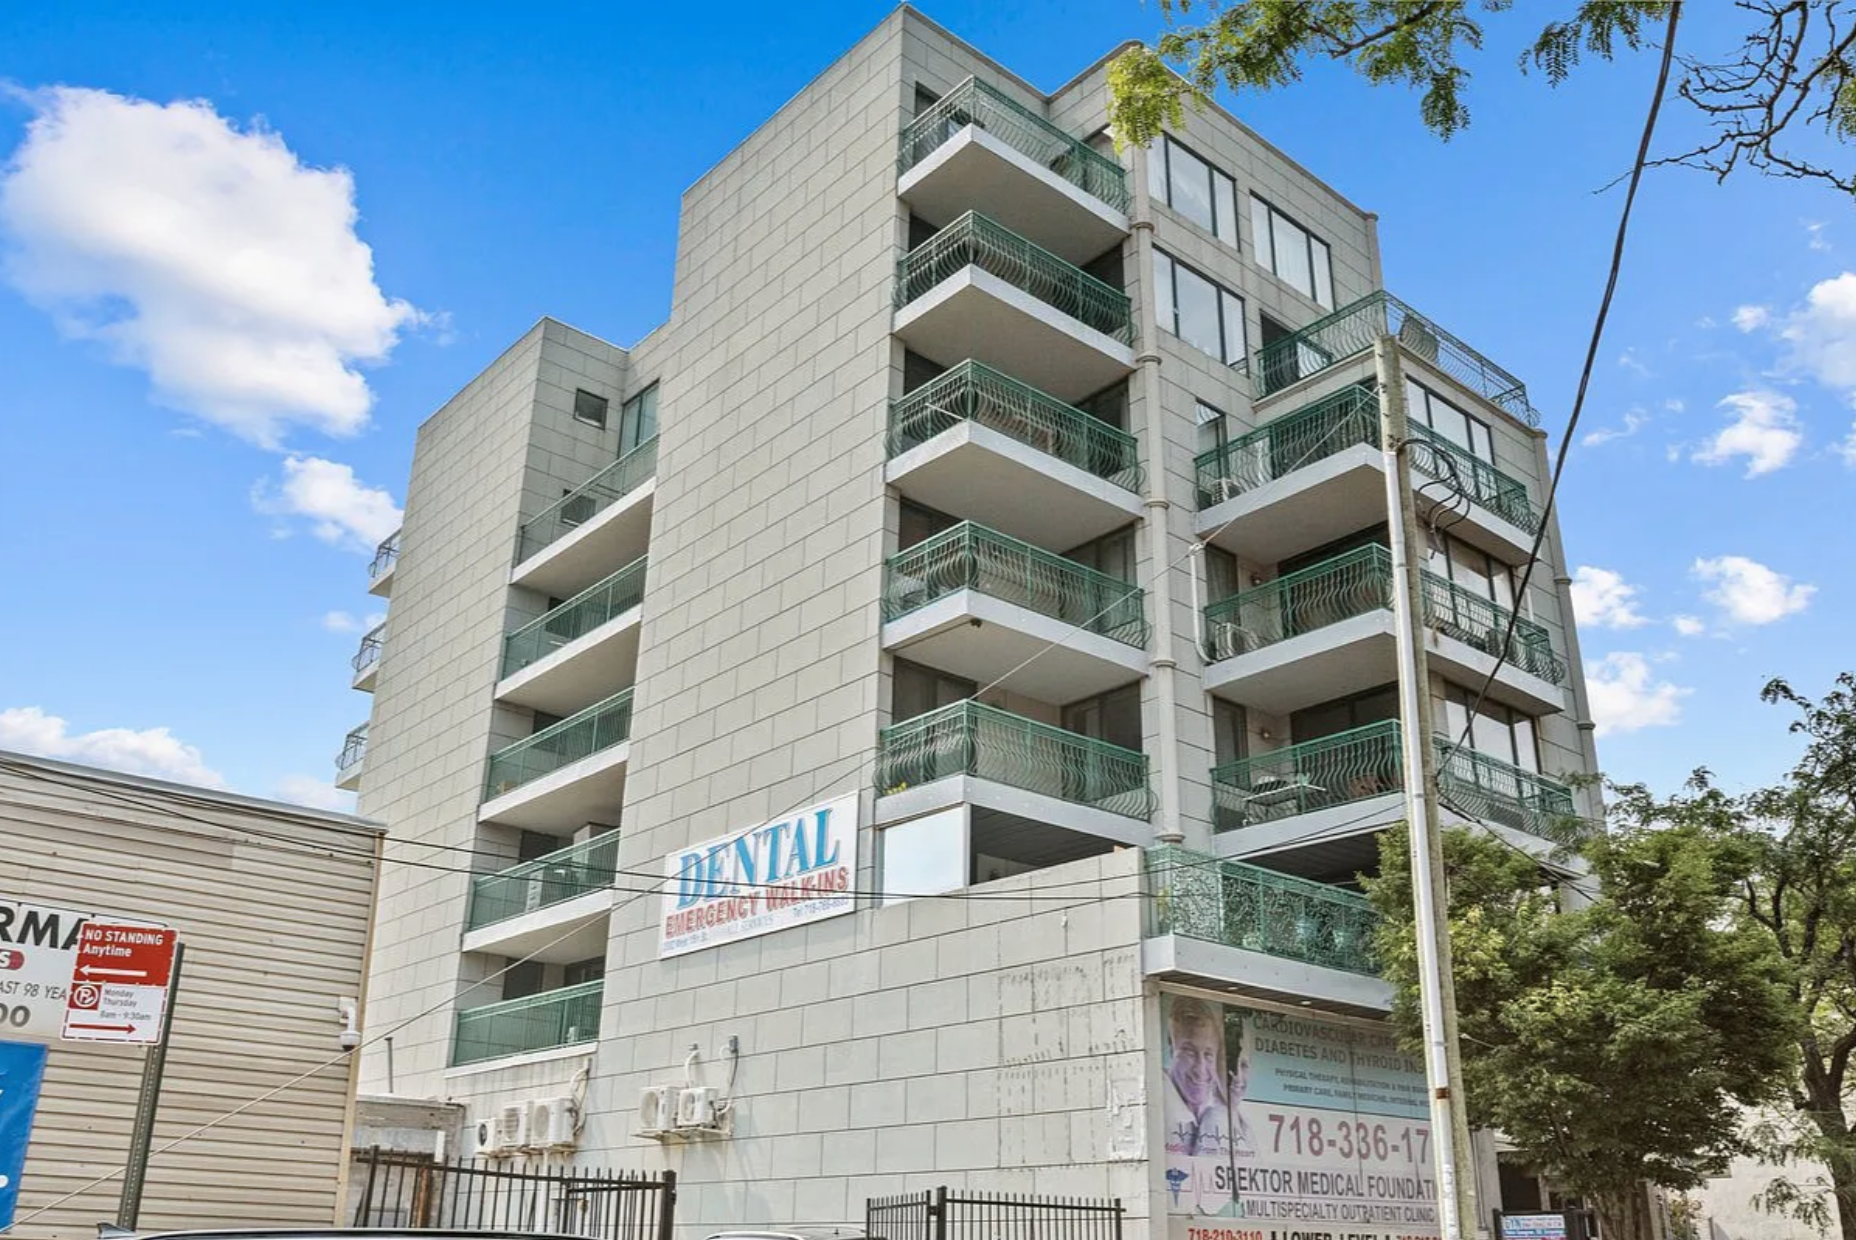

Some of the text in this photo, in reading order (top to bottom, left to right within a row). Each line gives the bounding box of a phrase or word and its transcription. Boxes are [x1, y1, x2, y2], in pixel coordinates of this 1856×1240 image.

[675, 807, 841, 911] DENTAL
[665, 890, 761, 939] EMERGENCY
[765, 866, 849, 911] WALK-INS
[84, 929, 163, 946] NO STANDING
[83, 943, 132, 958] Anytime
[24, 983, 40, 998] 98
[44, 986, 67, 1001] YEA
[104, 997, 137, 1007] Thursday
[105, 988, 134, 998] Monday
[101, 1010, 116, 1019] 8am
[123, 1011, 151, 1020] 9:30am
[1253, 1011, 1366, 1043] CARDIOVASCULAR
[1255, 1036, 1317, 1060] DIABETES
[1320, 1046, 1346, 1063] AND
[1348, 1050, 1401, 1071] THYROID
[1268, 1113, 1429, 1164] 718-336-17
[1297, 1171, 1364, 1196] MEDICAL
[1368, 1175, 1437, 1200] FOUNDATI
[1246, 1199, 1435, 1223] MULTISPECIALTY OUTPATIENT CLINIC
